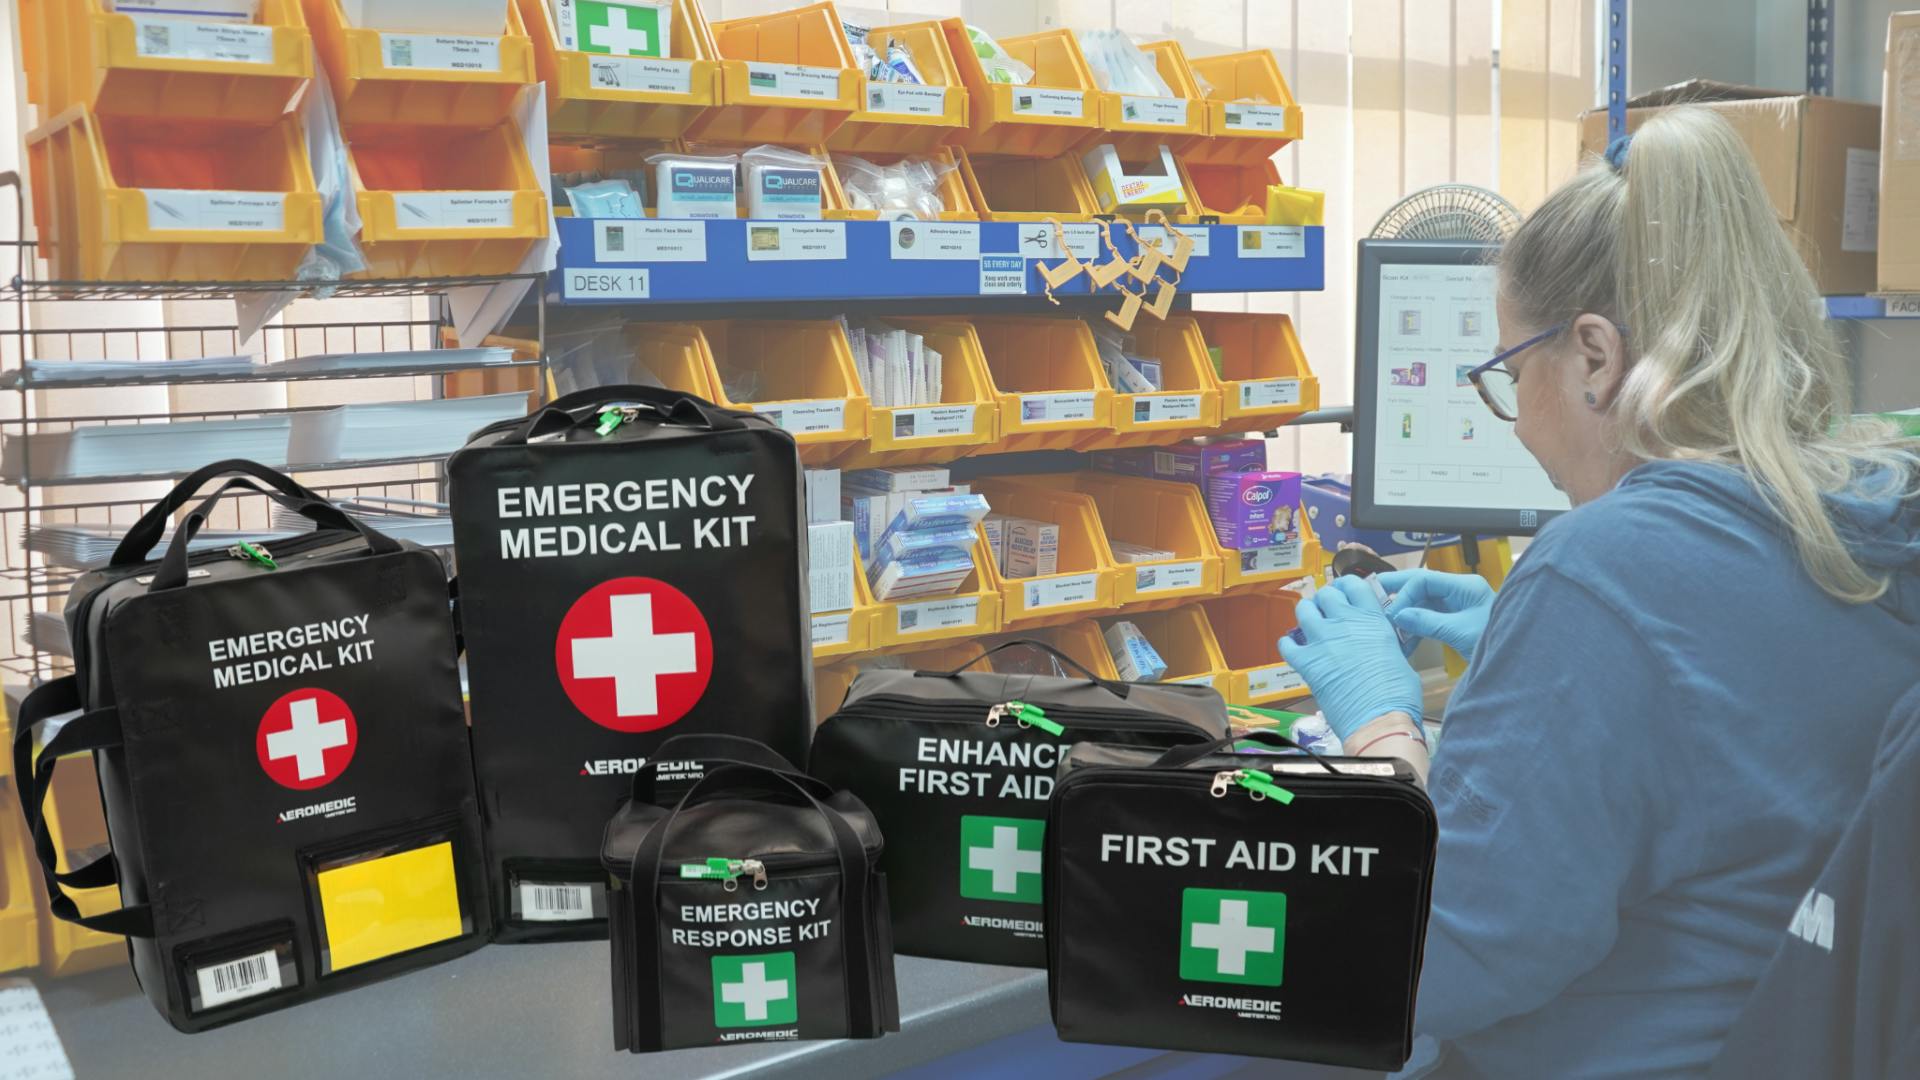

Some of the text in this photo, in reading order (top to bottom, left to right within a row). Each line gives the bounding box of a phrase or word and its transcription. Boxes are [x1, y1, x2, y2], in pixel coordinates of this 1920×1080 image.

[675, 173, 731, 188] QUALICARE
[765, 175, 817, 189] QUALICARE
[992, 260, 1010, 268] EVERY
[1010, 260, 1023, 268] DAY
[575, 275, 645, 291] DESK 11
[985, 275, 997, 283] Keep
[1892, 302, 1920, 313] FAC
[497, 473, 755, 519] EMERGENCY
[1245, 490, 1270, 503] Calpol
[499, 515, 756, 560] MEDICAL KIT
[208, 613, 370, 662] EMERGENCY
[213, 639, 375, 689] MEDICAL KIT
[579, 757, 704, 776] AEROEDIC
[898, 767, 1056, 800] FIRST AID
[276, 796, 356, 824] AEROMEDIC
[1101, 833, 1379, 877] FIRST AID KIT
[681, 898, 820, 923] EMERGENCY
[671, 919, 832, 948] RESPONSE KIT
[1178, 993, 1282, 1013] AEROMEDIC
[713, 1029, 799, 1043] AEROMEDIC
